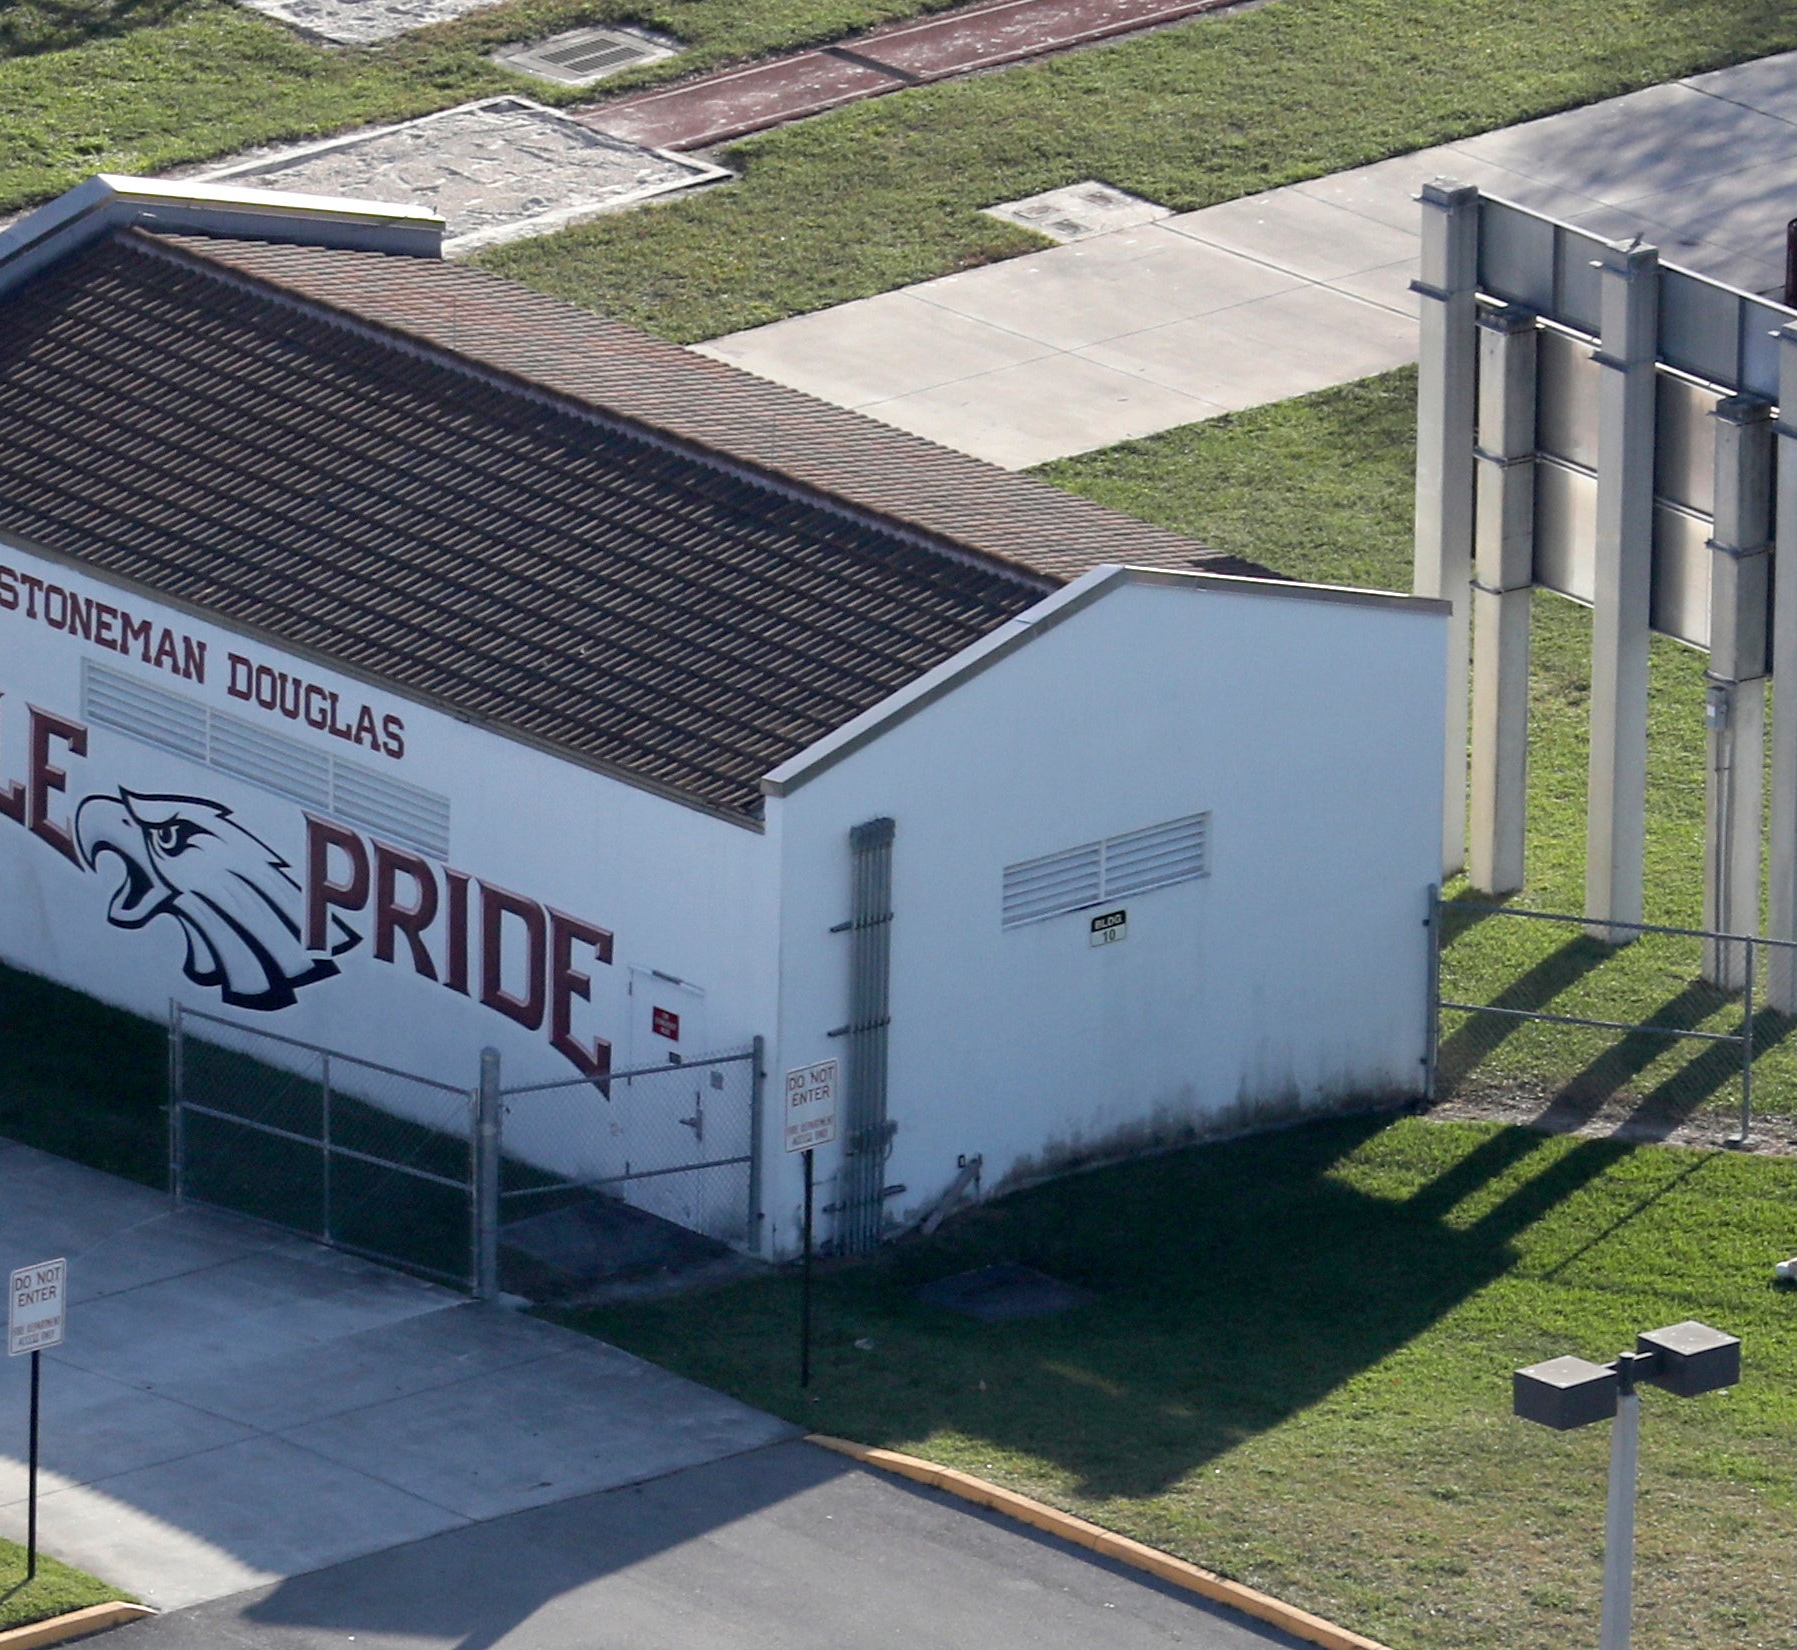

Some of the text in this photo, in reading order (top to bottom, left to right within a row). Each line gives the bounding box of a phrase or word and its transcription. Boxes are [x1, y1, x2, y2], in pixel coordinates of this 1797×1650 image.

[228, 652, 405, 760] DOUGLAS
[1103, 929, 1116, 943] 10
[301, 809, 614, 1102] PRIDE
[789, 1066, 834, 1091] DO NOT
[793, 1086, 829, 1106] ENTER
[15, 1267, 61, 1291] DO NOT
[18, 1286, 57, 1307] ENTER
